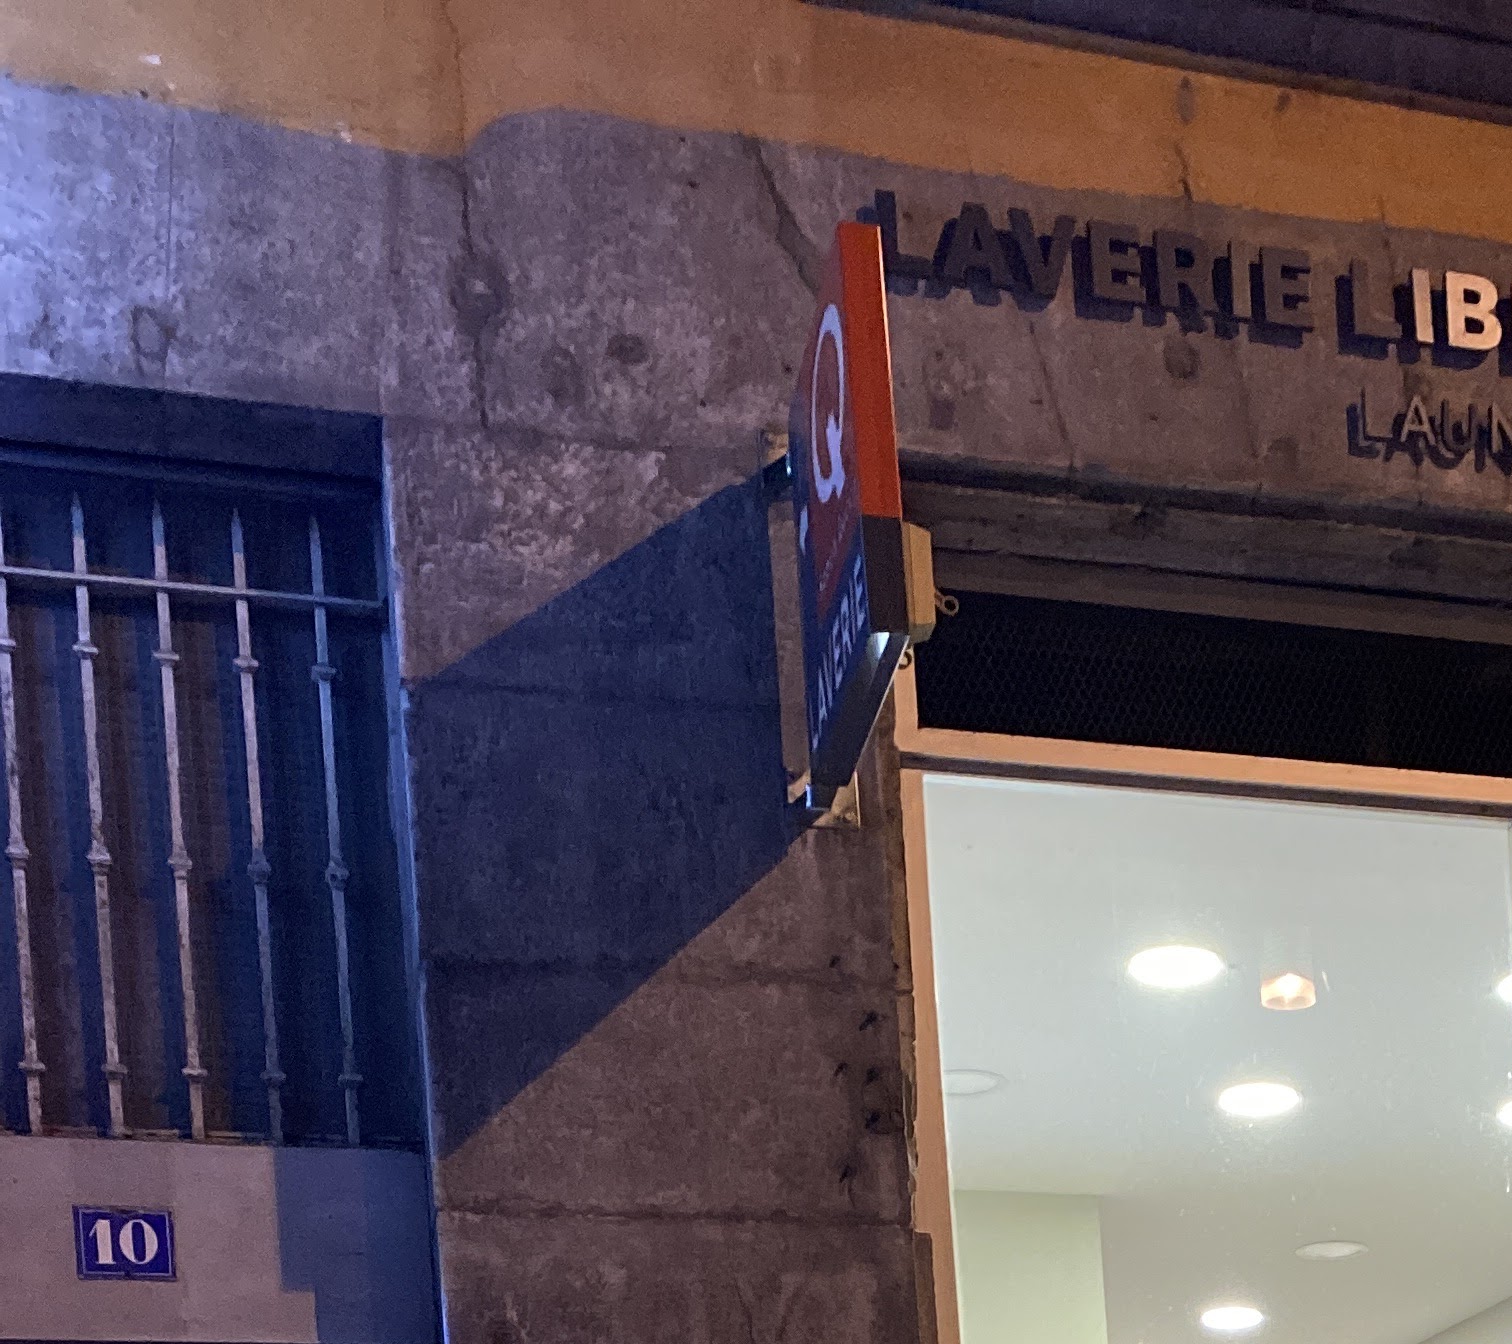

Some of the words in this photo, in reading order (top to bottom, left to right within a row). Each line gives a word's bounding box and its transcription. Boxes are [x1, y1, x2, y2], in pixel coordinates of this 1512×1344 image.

[870, 189, 1314, 327] LAVERIE
[807, 554, 866, 754] LAVERIE
[87, 1218, 159, 1267] 10
